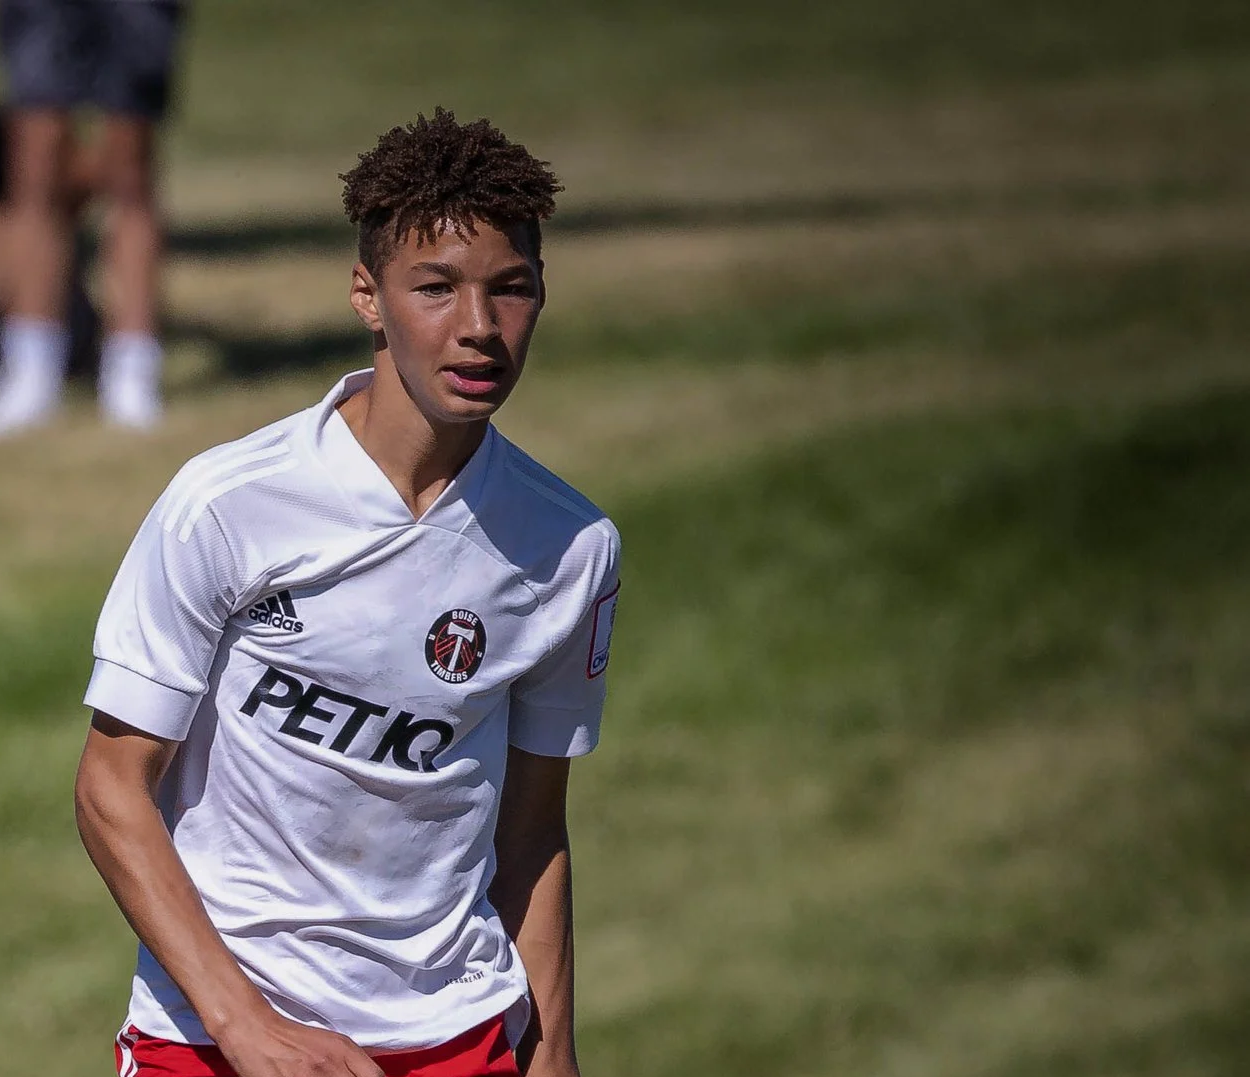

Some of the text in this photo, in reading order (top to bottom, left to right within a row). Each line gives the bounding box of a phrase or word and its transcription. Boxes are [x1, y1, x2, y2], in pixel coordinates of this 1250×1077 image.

[248, 608, 304, 633] adidas
[452, 610, 478, 626] BOISE
[431, 660, 468, 682] TIMBERS
[239, 666, 455, 773] PETIQ
